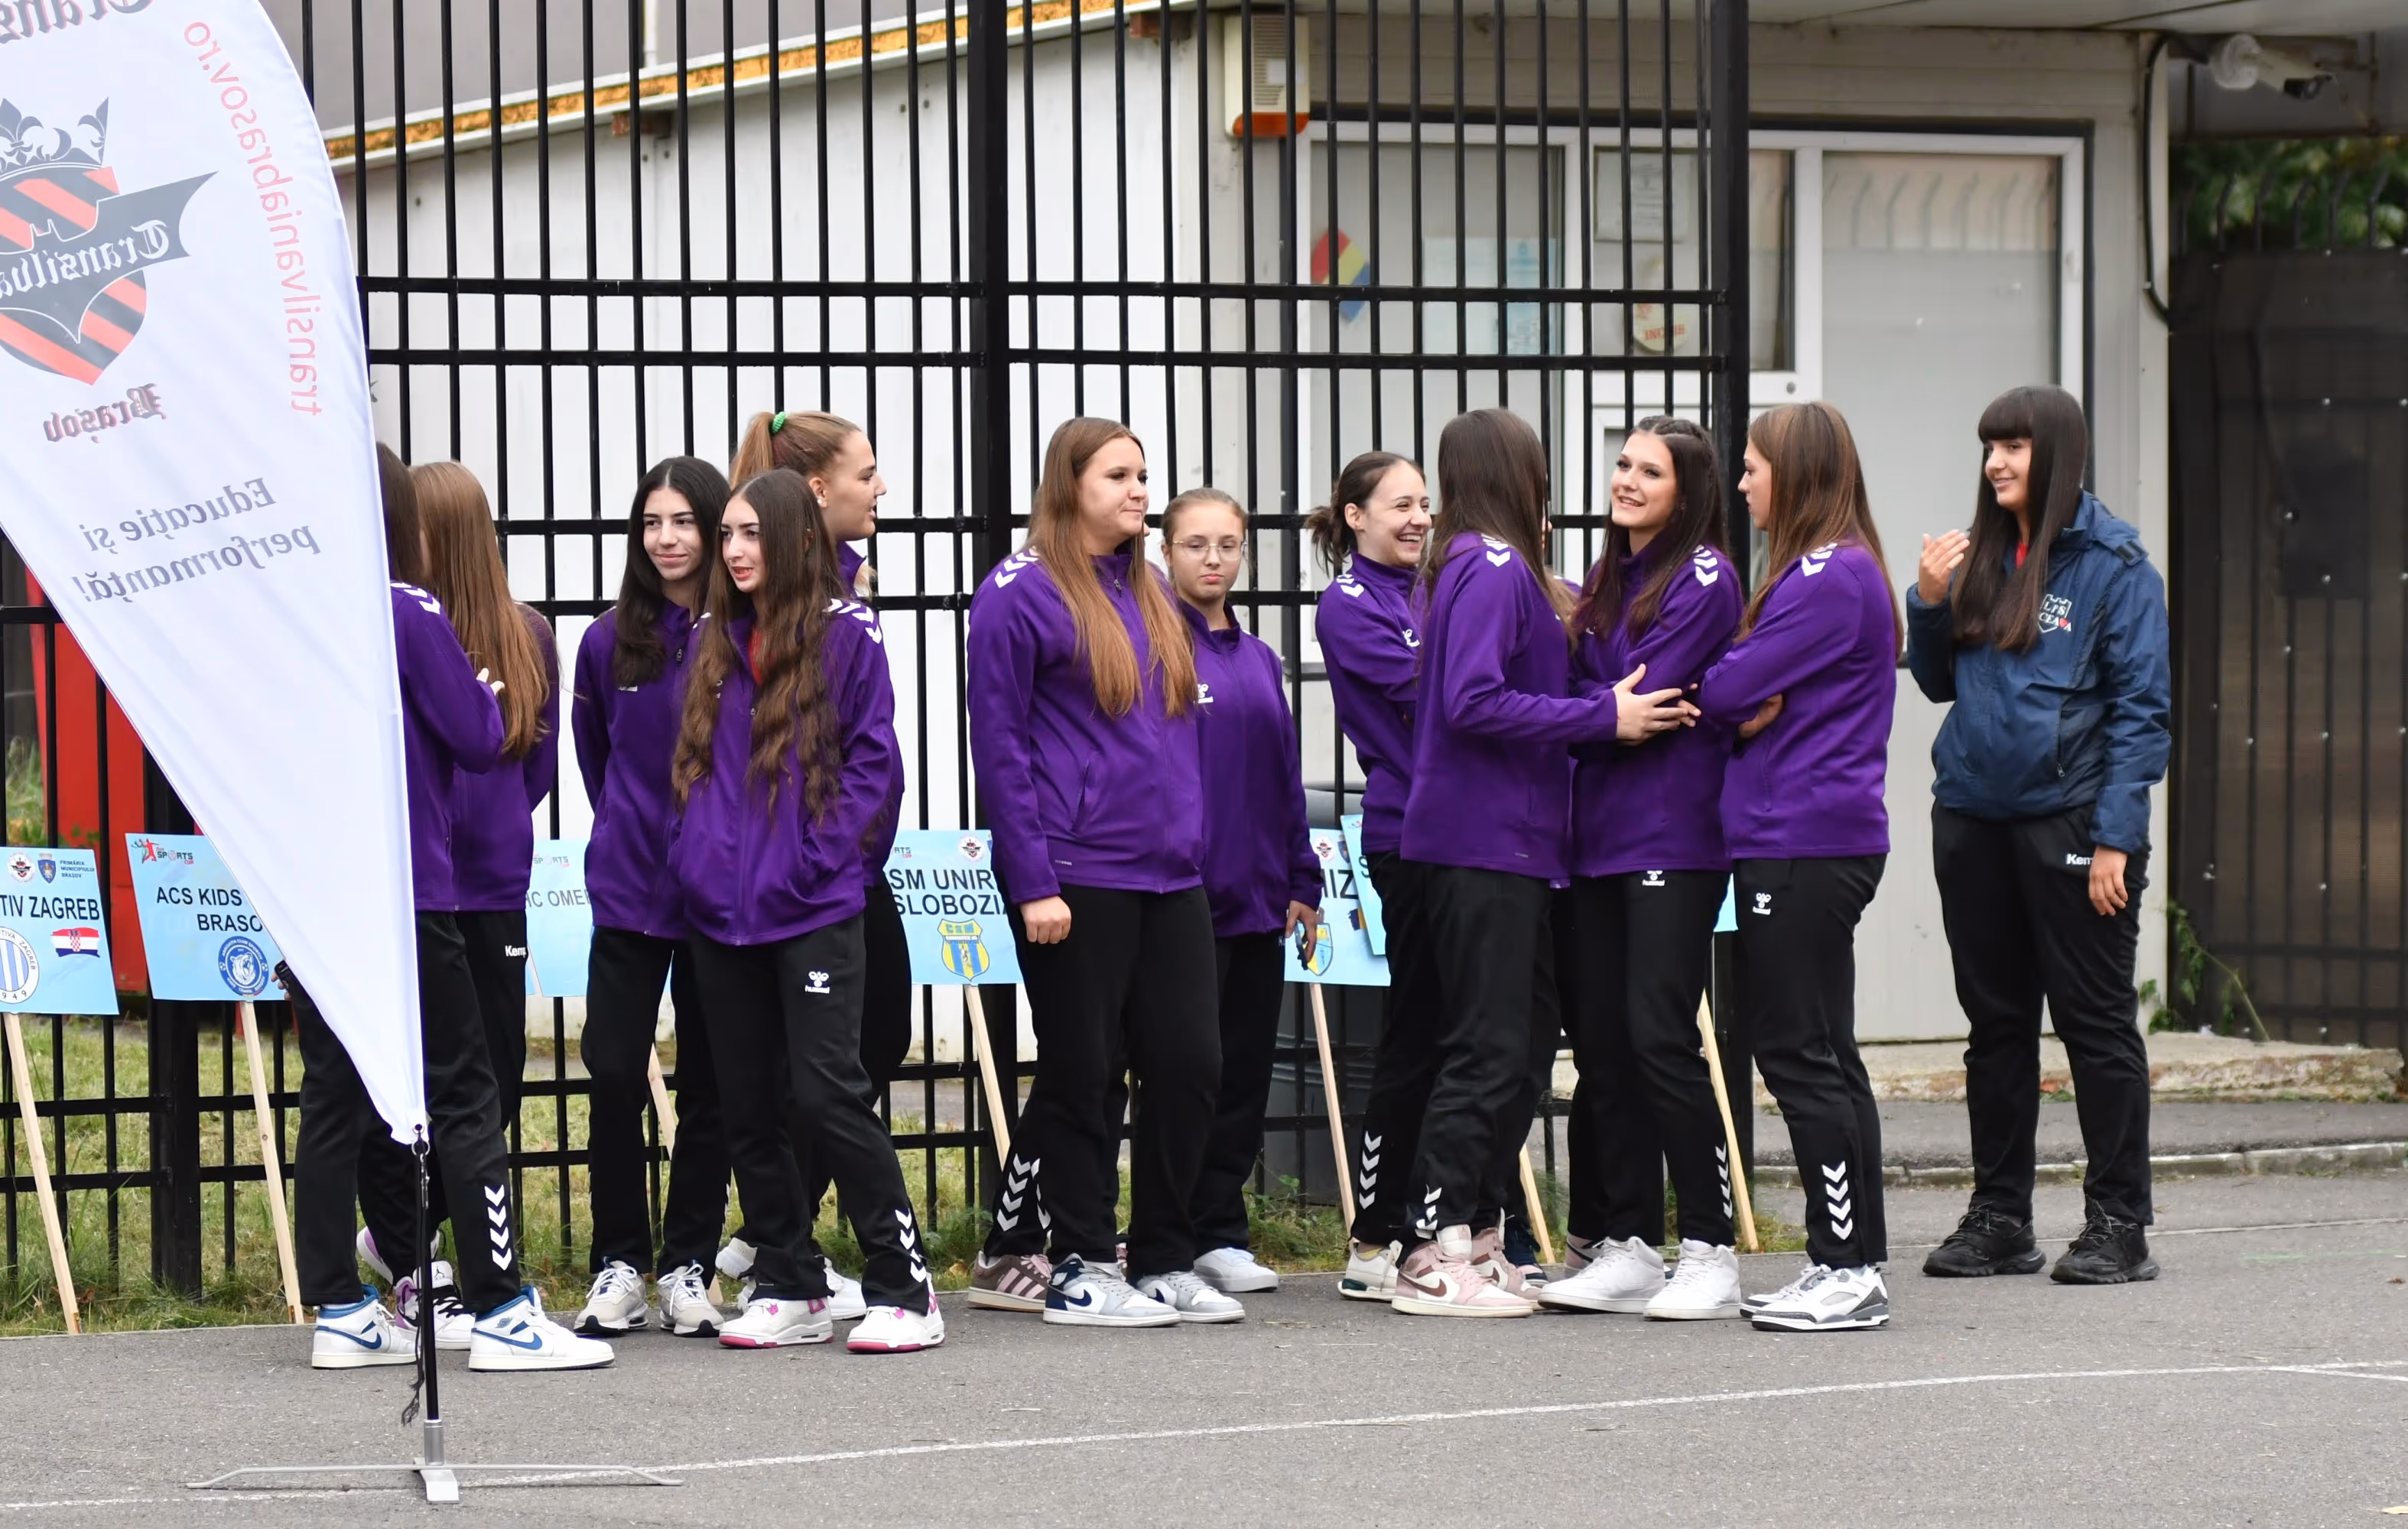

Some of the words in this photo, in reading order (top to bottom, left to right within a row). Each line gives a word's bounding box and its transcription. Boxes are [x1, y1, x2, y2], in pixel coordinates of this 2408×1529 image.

[29, 896, 100, 920] ZAGREB
[156, 887, 193, 905] ACS
[199, 888, 242, 907] KIDS
[19, 940, 37, 970] ZAGREB
